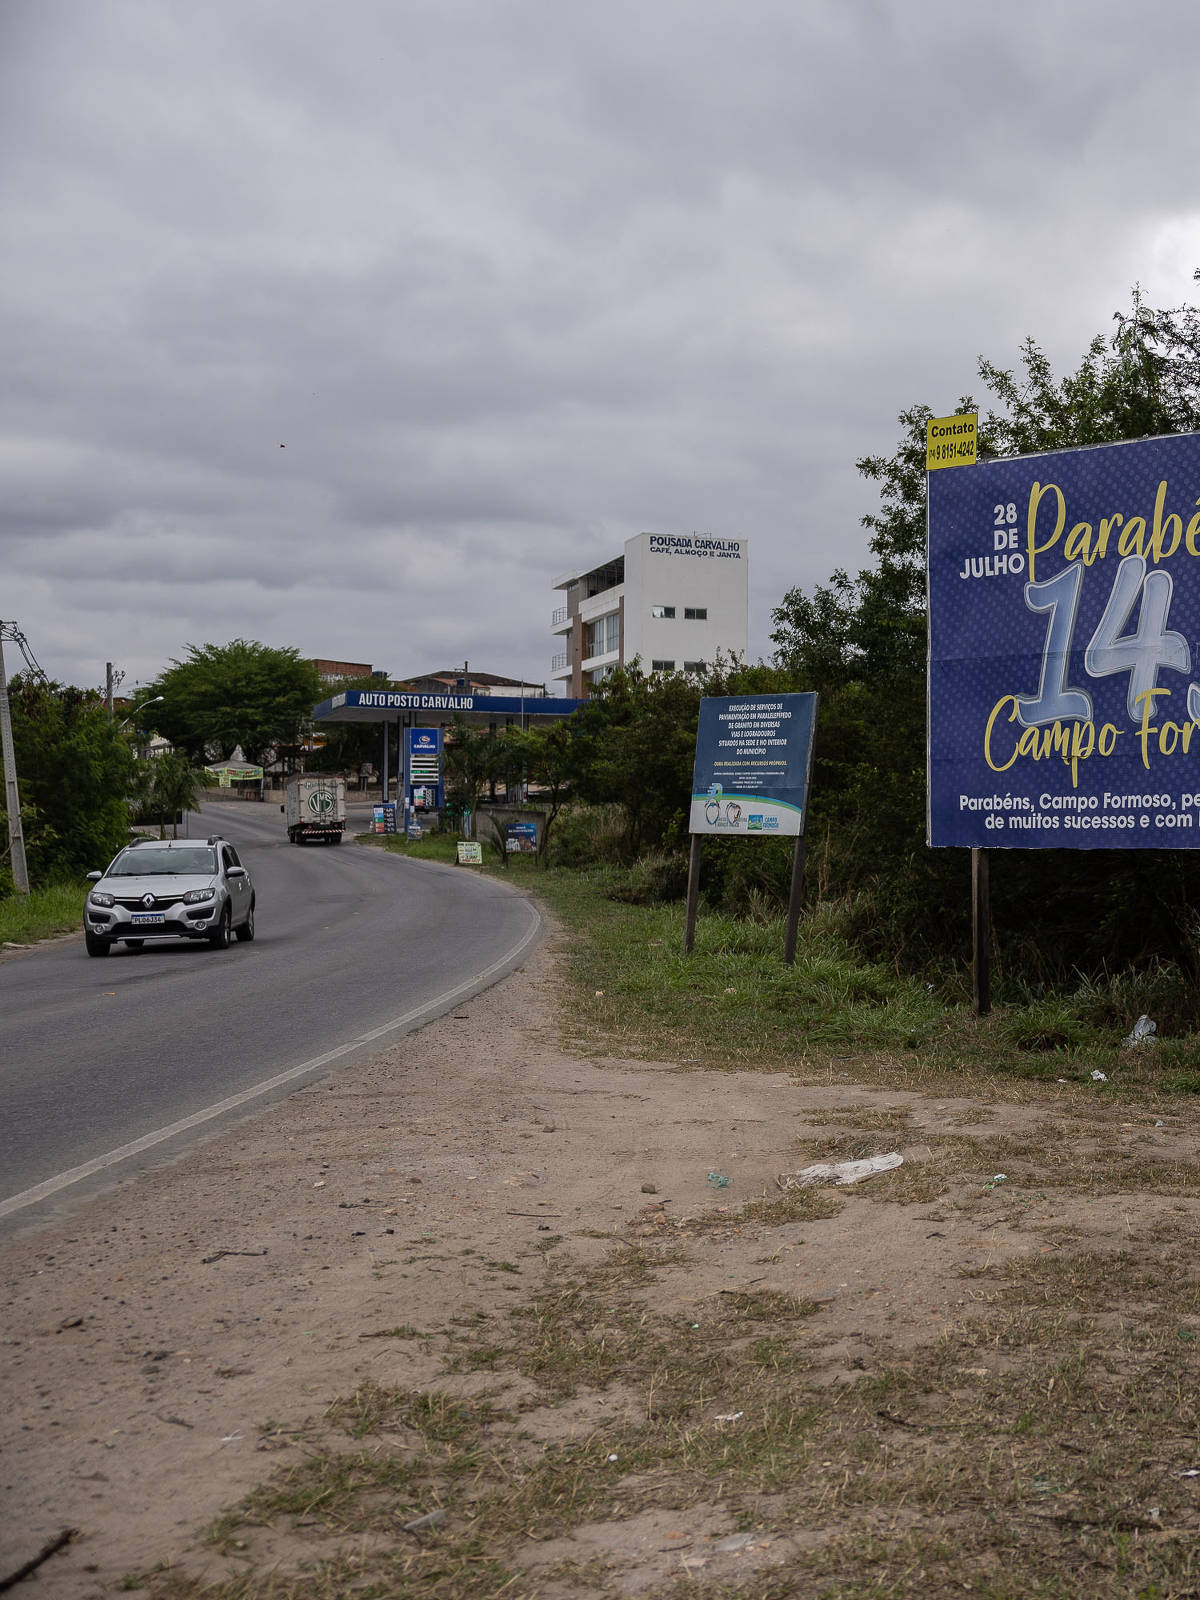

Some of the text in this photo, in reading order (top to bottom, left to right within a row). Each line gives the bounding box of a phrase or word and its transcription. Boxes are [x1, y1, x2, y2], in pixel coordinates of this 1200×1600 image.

[931, 422, 974, 438] Contato
[993, 502, 1018, 525] 28
[650, 536, 740, 551] POUSADA CARVALHO
[993, 527, 1019, 551] DE
[650, 546, 672, 555] CAFÉ,
[674, 548, 708, 557] ALMOÇO
[716, 551, 741, 559] JANTA
[959, 553, 1025, 580] JULHO
[358, 692, 474, 709] AUTO POSTO CARVALHO
[984, 694, 1125, 788] Campo
[959, 792, 1035, 812] Parabéns,
[1039, 793, 1099, 813] Campo
[1103, 792, 1176, 810] Formoso,
[985, 813, 1005, 829] de
[1009, 812, 1060, 829] muitos
[1064, 814, 1135, 829] sucessos
[1139, 814, 1150, 828] e
[1155, 813, 1193, 828] com
